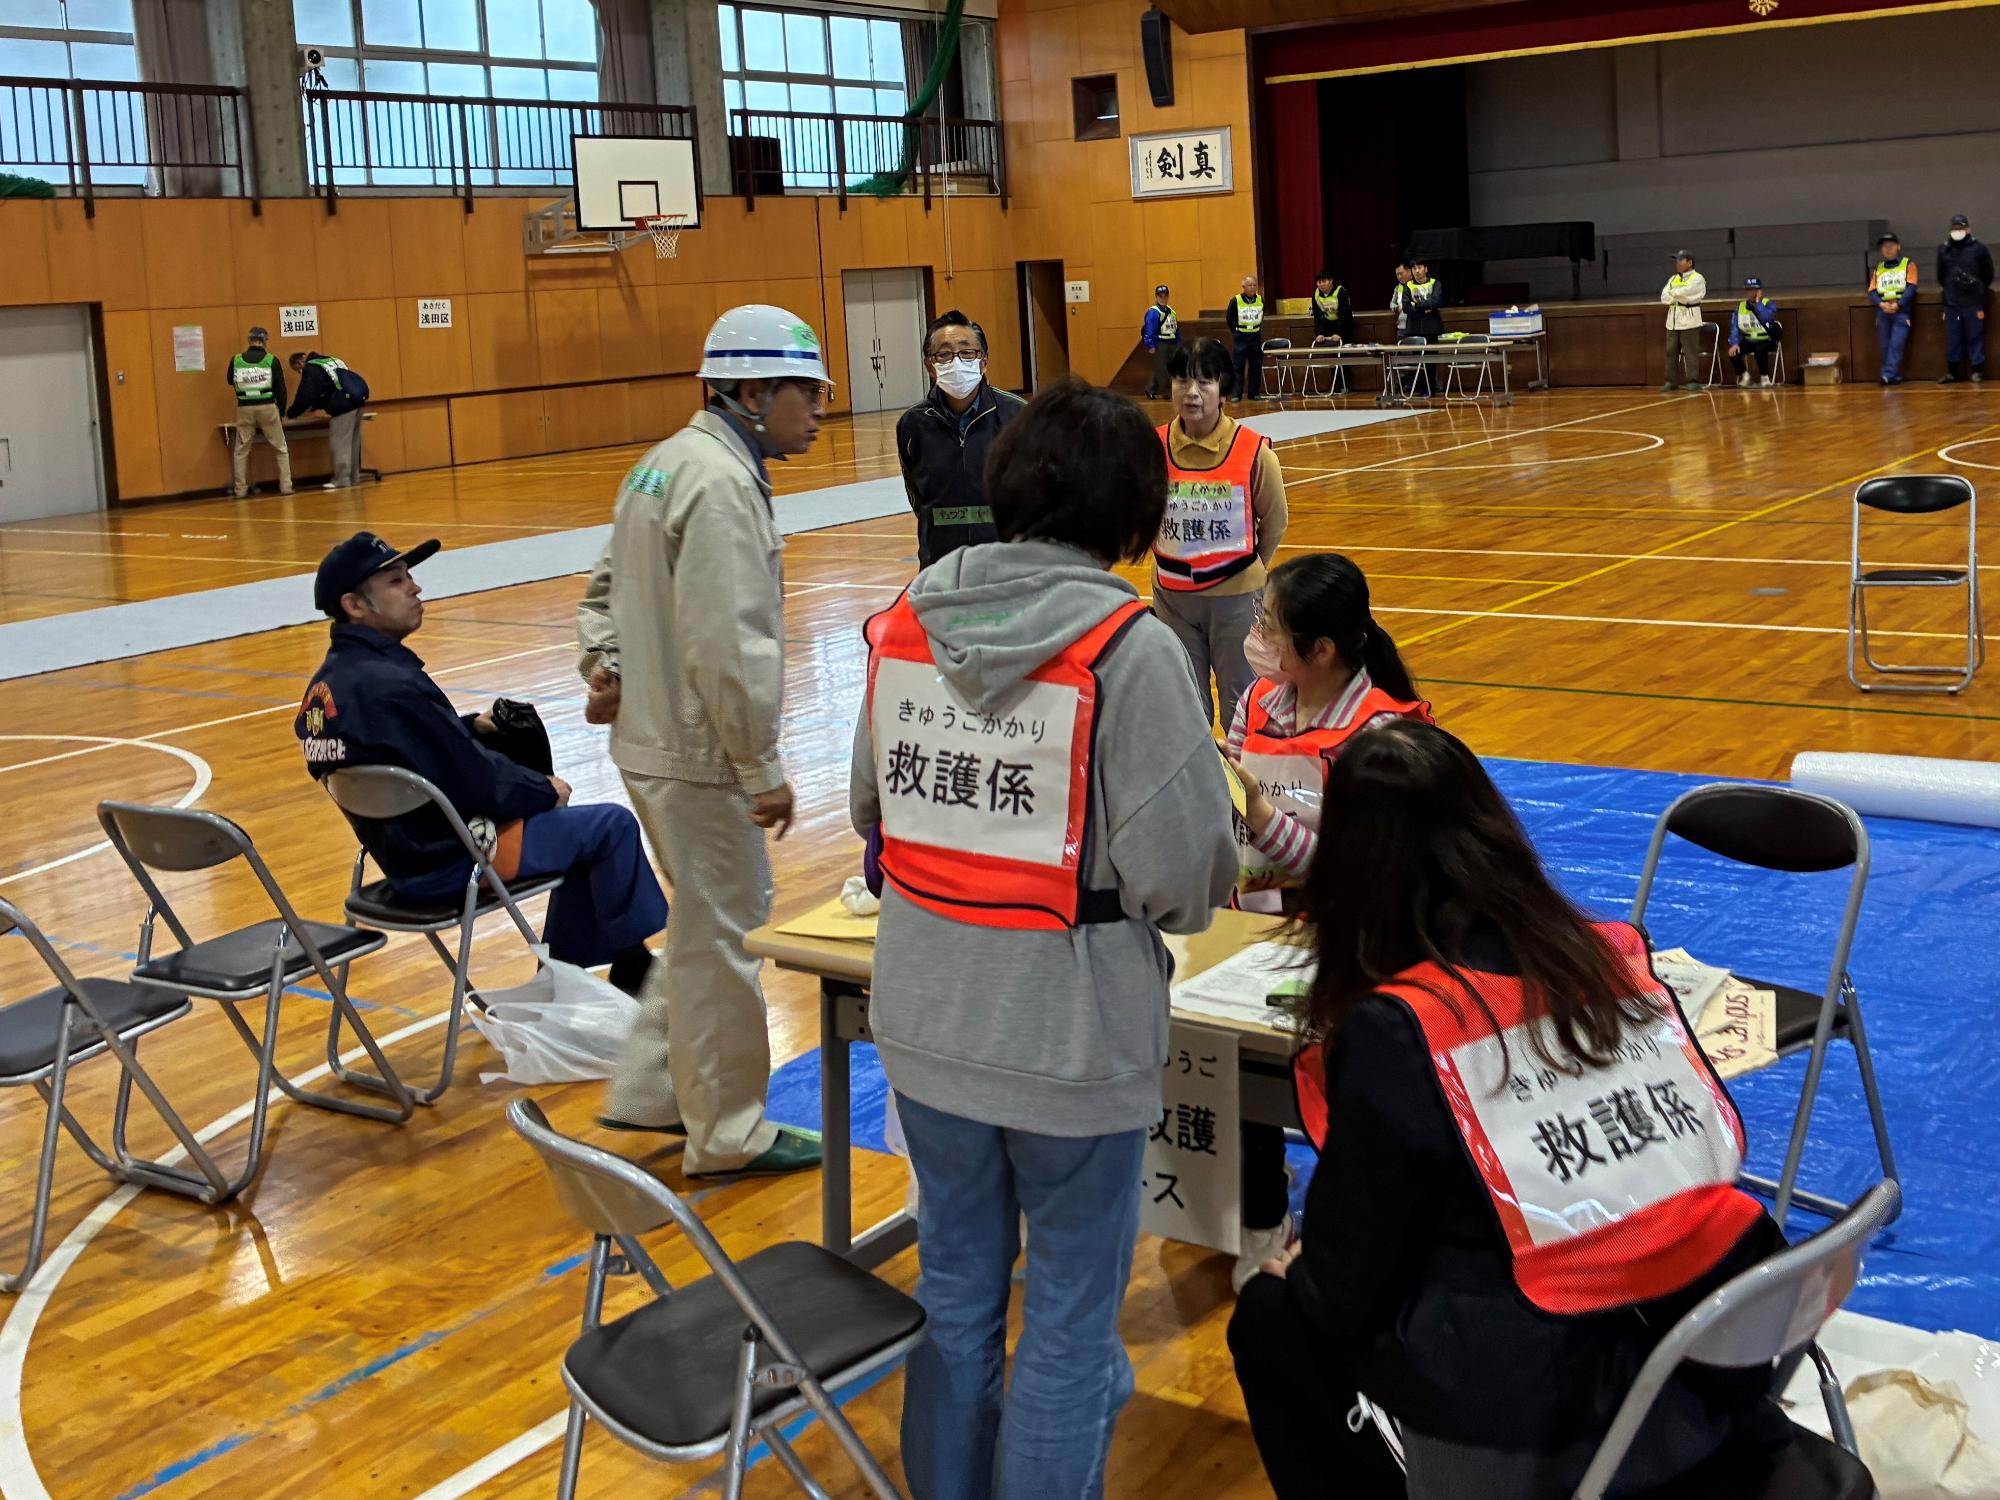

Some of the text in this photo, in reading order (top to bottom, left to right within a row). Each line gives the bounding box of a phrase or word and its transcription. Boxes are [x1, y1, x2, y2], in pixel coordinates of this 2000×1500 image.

[283, 320, 316, 333] 浅田区
[421, 313, 450, 324] 浅田区
[1168, 499, 1233, 513] ゅうごかかり
[1161, 517, 1233, 543] 救護係
[898, 697, 1046, 744] きゅうごかかり
[884, 740, 1036, 816] 救護係
[1530, 1078, 1704, 1185] 救護係
